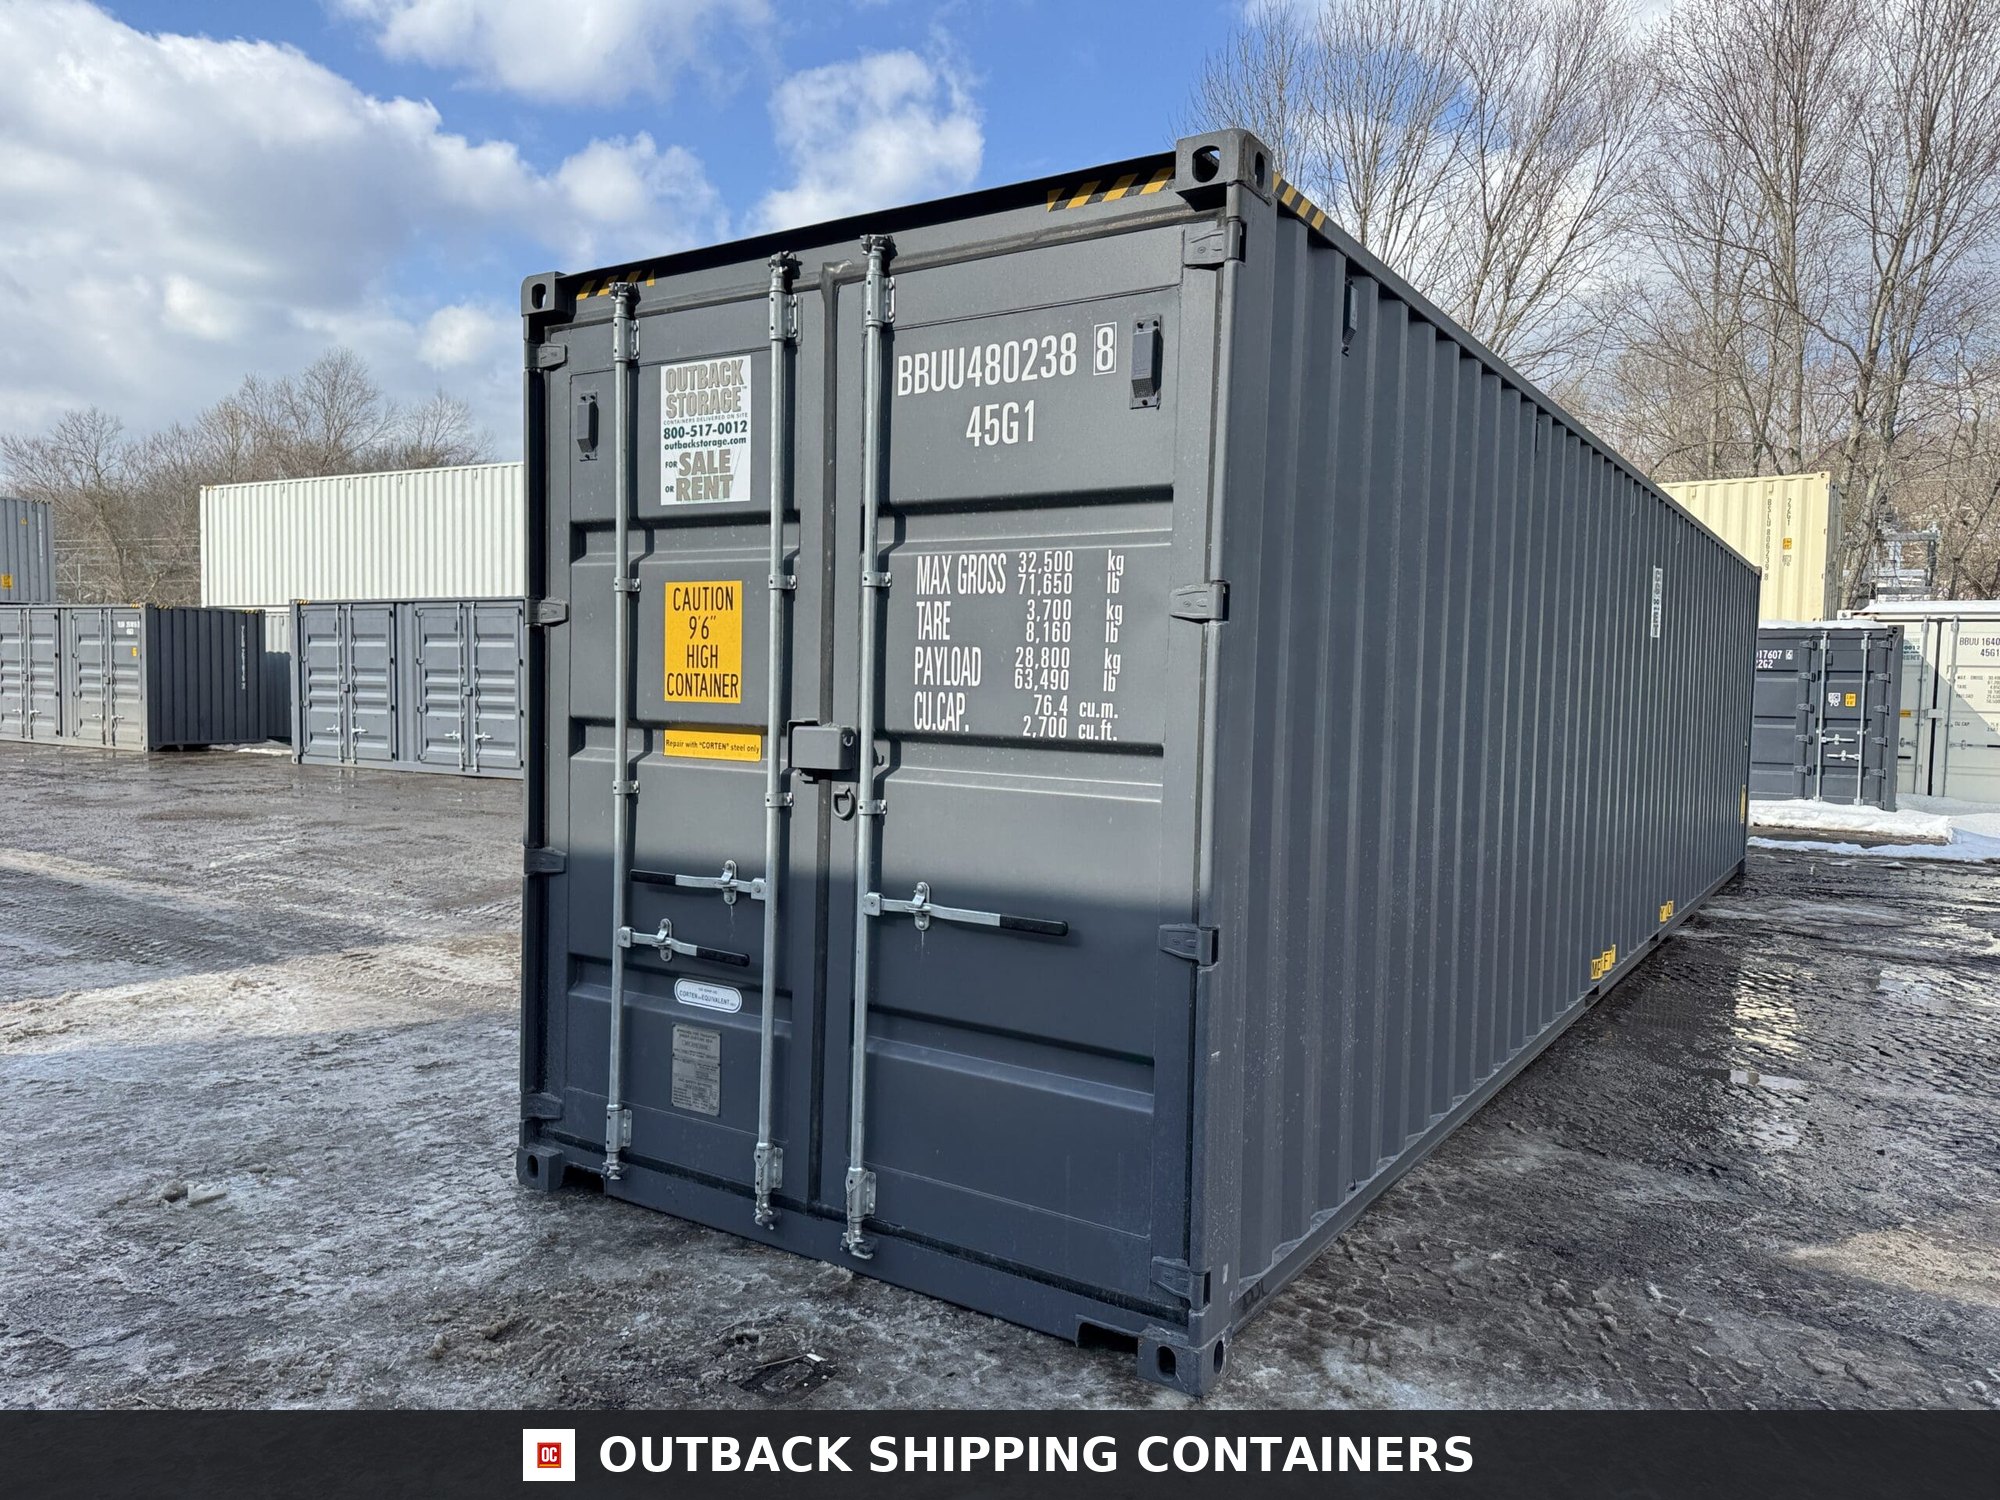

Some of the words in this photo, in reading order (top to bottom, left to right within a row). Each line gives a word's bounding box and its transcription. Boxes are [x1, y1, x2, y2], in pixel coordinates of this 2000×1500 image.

[898, 332, 1077, 396] BBUU480238
[1096, 326, 1114, 371] 8
[666, 359, 744, 393] OUTBACK
[666, 386, 742, 419] STORAGE
[664, 420, 747, 439] 800-517-0012
[696, 415, 726, 423] DELIVERED
[966, 400, 1034, 447] 45G1
[664, 437, 746, 450] outbackstorage.com
[679, 449, 730, 476] SALE
[676, 474, 733, 501] RENT
[916, 555, 951, 595] MAX
[957, 553, 1007, 594] GROSS
[1018, 551, 1073, 574] 32,500
[1108, 549, 1124, 576] kg
[1018, 573, 1072, 596] 71,650
[1107, 572, 1120, 594] lb
[673, 586, 733, 611] CAUTION
[916, 601, 951, 640] TARE
[1027, 599, 1072, 622] 3,700
[1106, 599, 1123, 625] kg
[1026, 621, 1071, 643] 8,160
[1105, 621, 1118, 643] lb
[687, 645, 718, 668] HIGH
[914, 646, 981, 686] PAYLOAD
[1015, 647, 1070, 670] 28,800
[1104, 648, 1121, 675] kg
[667, 673, 738, 698] CONTAINER
[1015, 668, 1069, 691] 63,490
[1104, 670, 1116, 692] lb
[914, 691, 969, 732] CU.CAP.
[1034, 694, 1068, 716] 76.4
[1079, 701, 1118, 718] cu.m.
[1023, 716, 1067, 738] 2,700
[1078, 719, 1118, 741] cu.ft.
[666, 739, 684, 748] Repair
[699, 741, 729, 750] "CORTEN"
[747, 745, 760, 754] only
